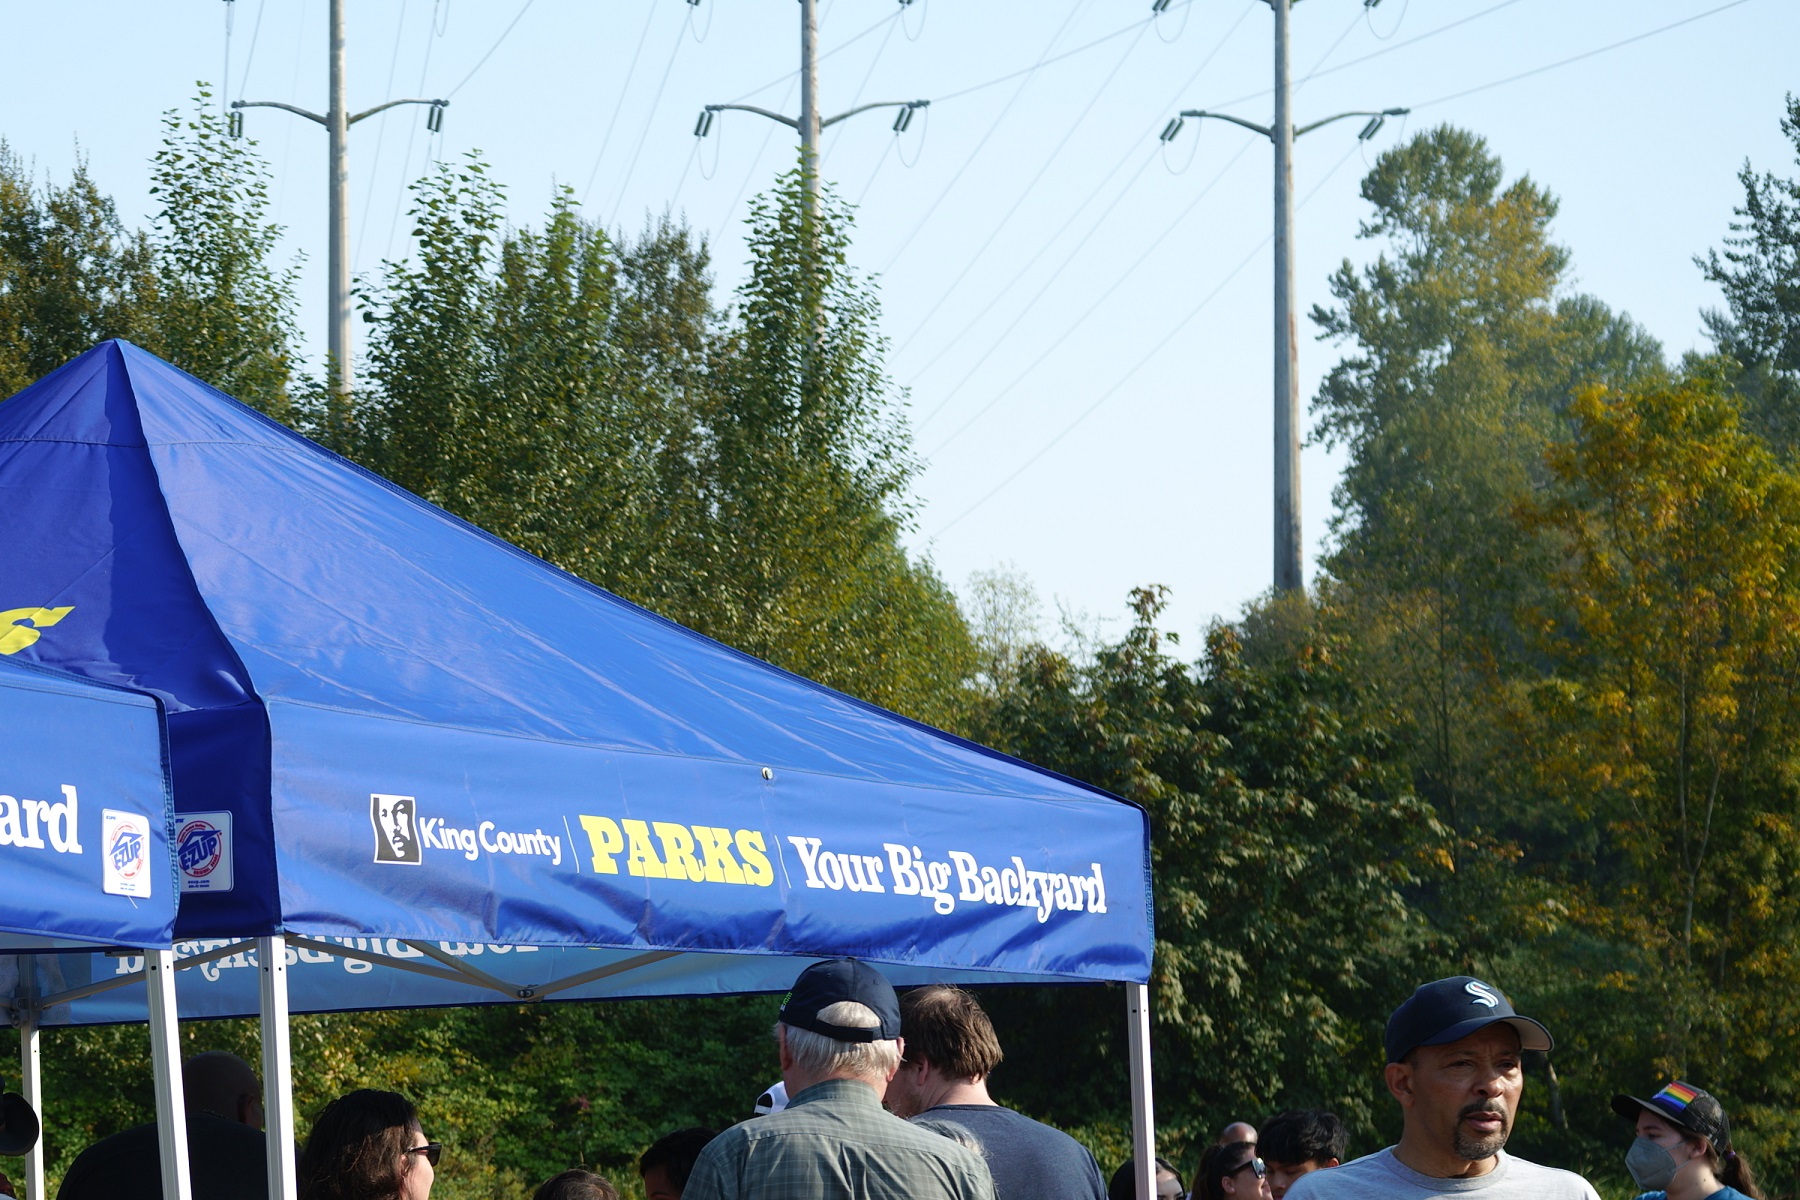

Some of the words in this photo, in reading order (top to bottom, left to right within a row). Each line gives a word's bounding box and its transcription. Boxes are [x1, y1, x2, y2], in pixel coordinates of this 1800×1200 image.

[418, 816, 479, 862] King
[479, 820, 562, 866] County
[579, 814, 775, 887] PARKS
[786, 835, 886, 894] Your
[890, 842, 956, 915] Big
[957, 850, 1108, 924] Backyard
